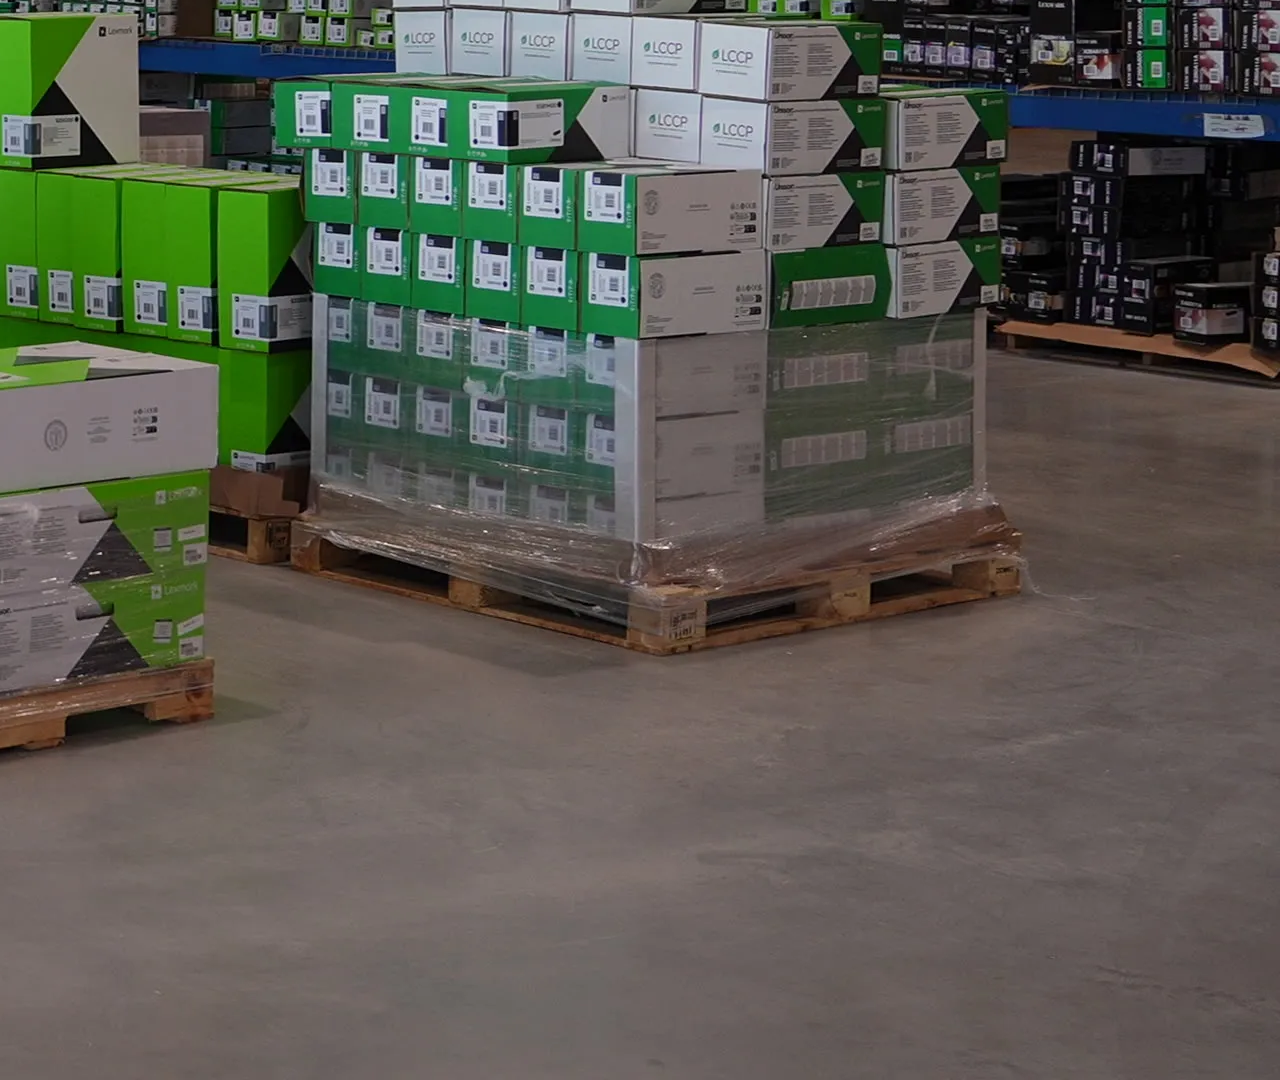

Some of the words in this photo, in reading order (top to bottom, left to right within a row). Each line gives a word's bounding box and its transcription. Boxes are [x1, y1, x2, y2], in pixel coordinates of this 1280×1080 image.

[108, 26, 133, 35] Lexmark
[411, 32, 435, 44] LCCP
[468, 32, 494, 44] LCCP
[529, 35, 555, 47] LCCP
[591, 38, 620, 50] LCCP
[652, 42, 683, 55] LCCP
[721, 49, 754, 64] LCCP
[657, 115, 688, 128] LCCP
[722, 123, 753, 137] LCCP
